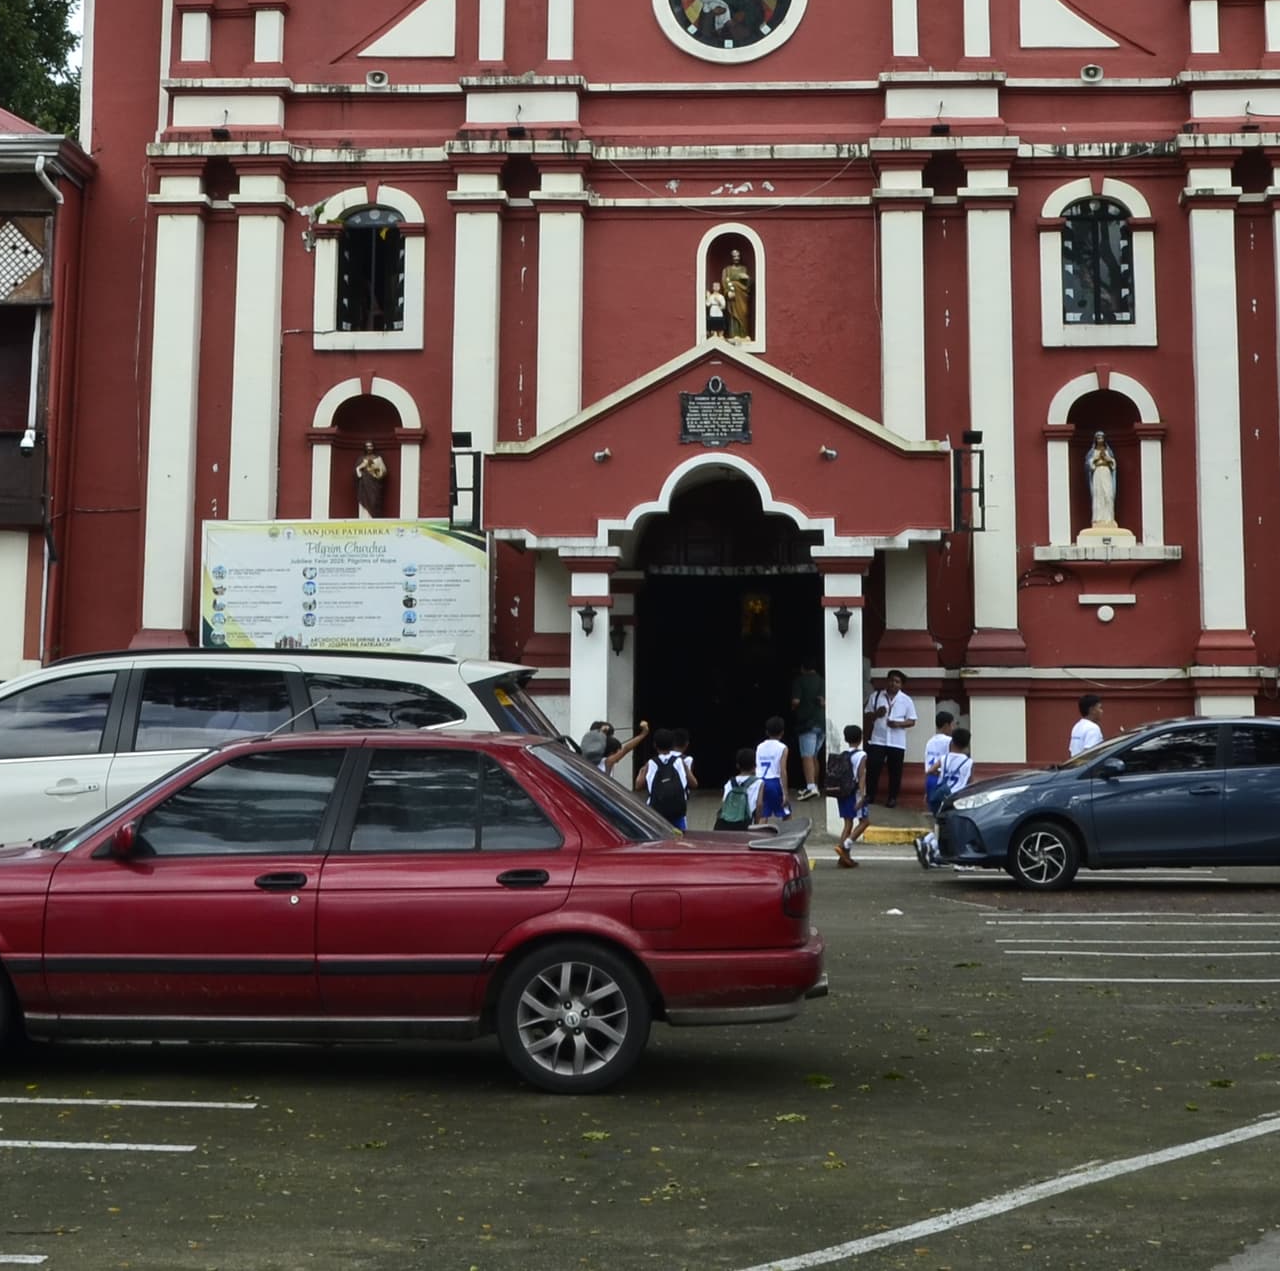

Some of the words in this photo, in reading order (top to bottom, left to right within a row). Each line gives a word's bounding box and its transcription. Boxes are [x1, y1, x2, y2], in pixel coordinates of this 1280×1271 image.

[321, 529, 338, 537] JOSE
[342, 528, 390, 536] PATRIARKA
[305, 541, 341, 557] Pilgrim
[344, 541, 387, 554] Churches
[761, 762, 771, 778] 7
